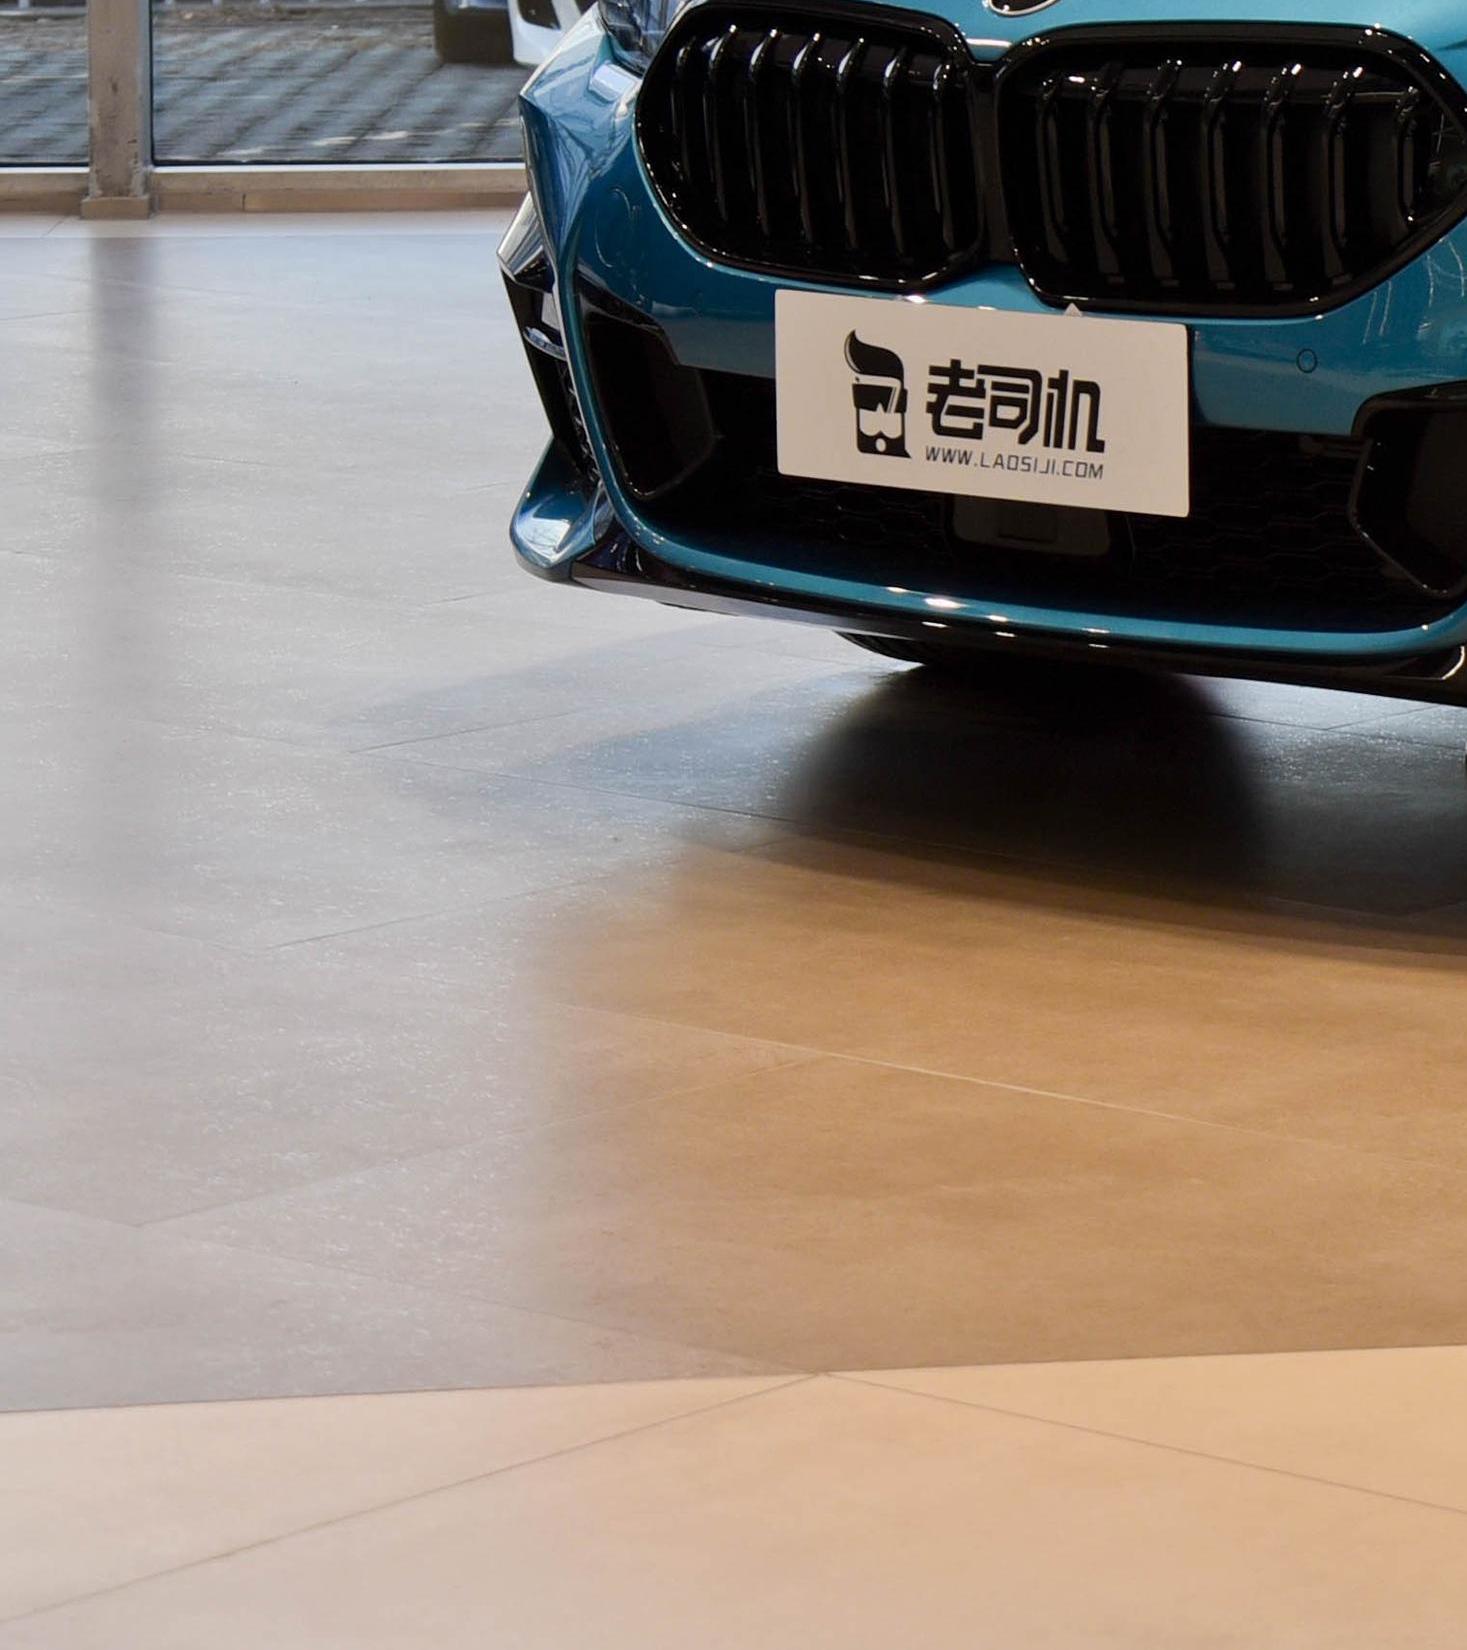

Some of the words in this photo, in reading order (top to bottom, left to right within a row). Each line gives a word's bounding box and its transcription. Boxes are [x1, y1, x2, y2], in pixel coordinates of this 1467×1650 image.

[926, 358, 1106, 454] 老司机
[925, 446, 1104, 480] WWW.LAOSIJI.COM
